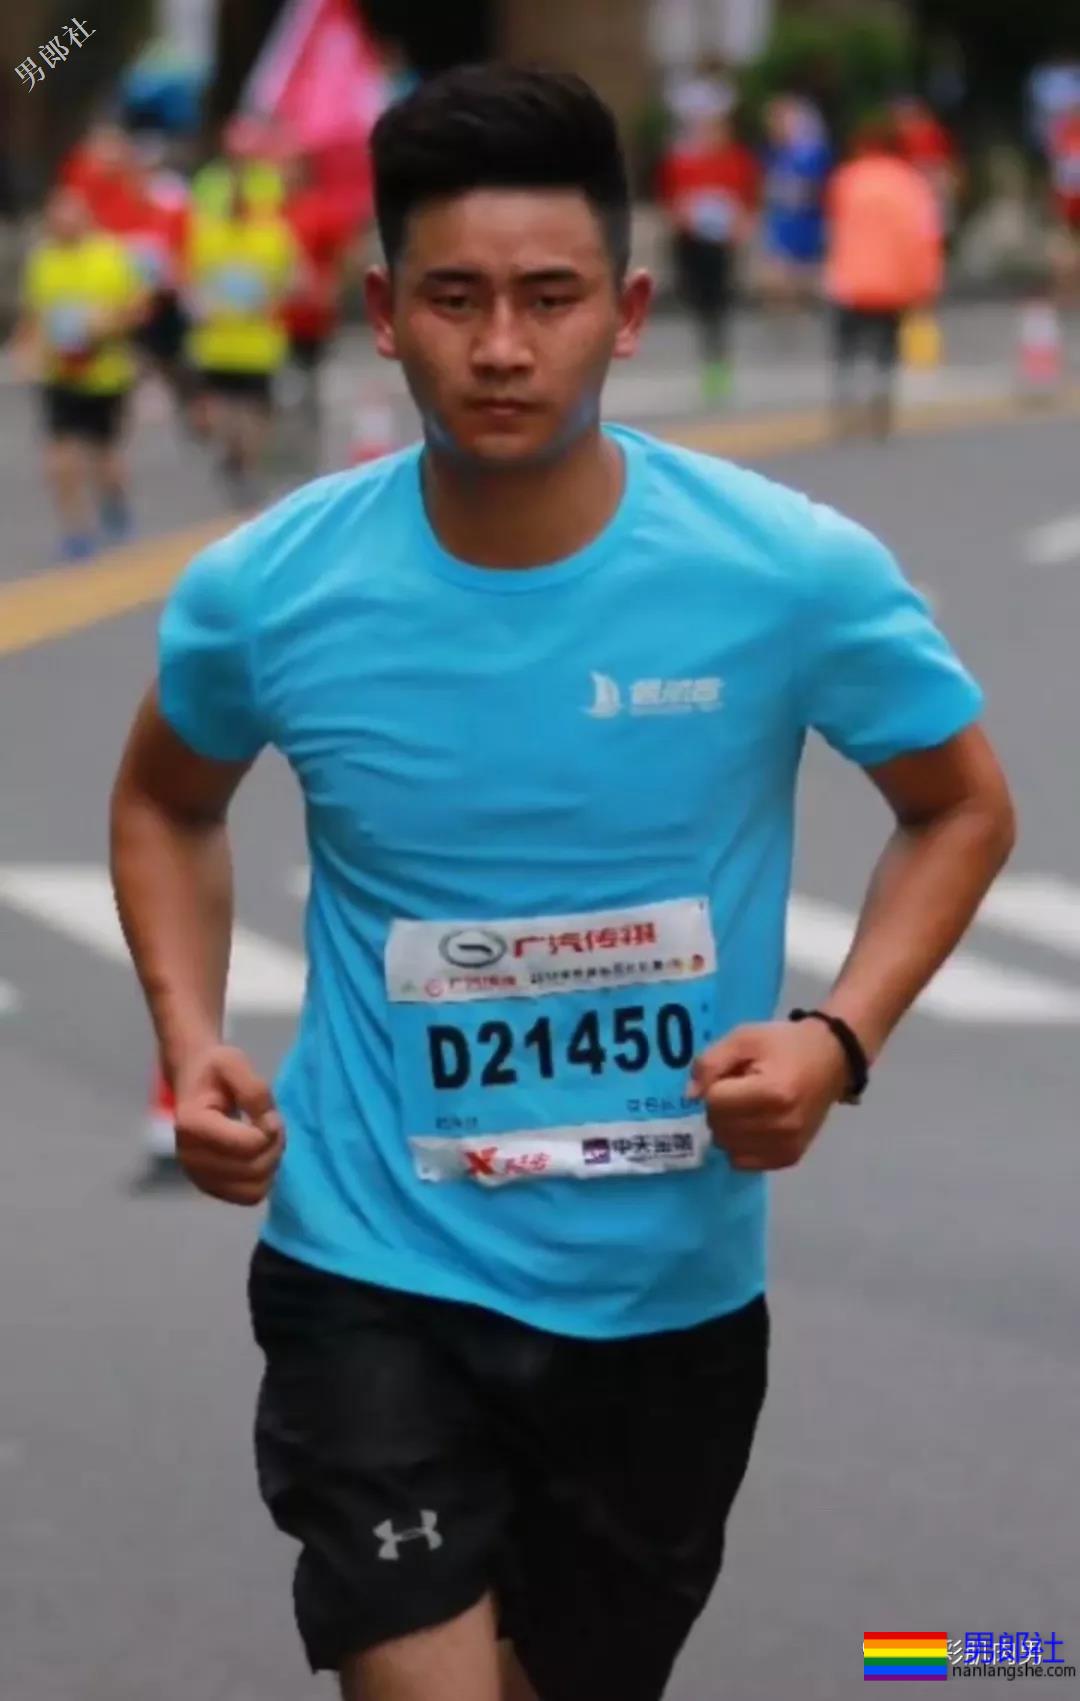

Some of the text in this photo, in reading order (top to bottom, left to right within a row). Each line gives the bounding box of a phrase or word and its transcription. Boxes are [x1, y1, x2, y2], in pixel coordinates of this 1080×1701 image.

[513, 922, 656, 959] 广汽传祺
[427, 1003, 694, 1090] D21450
